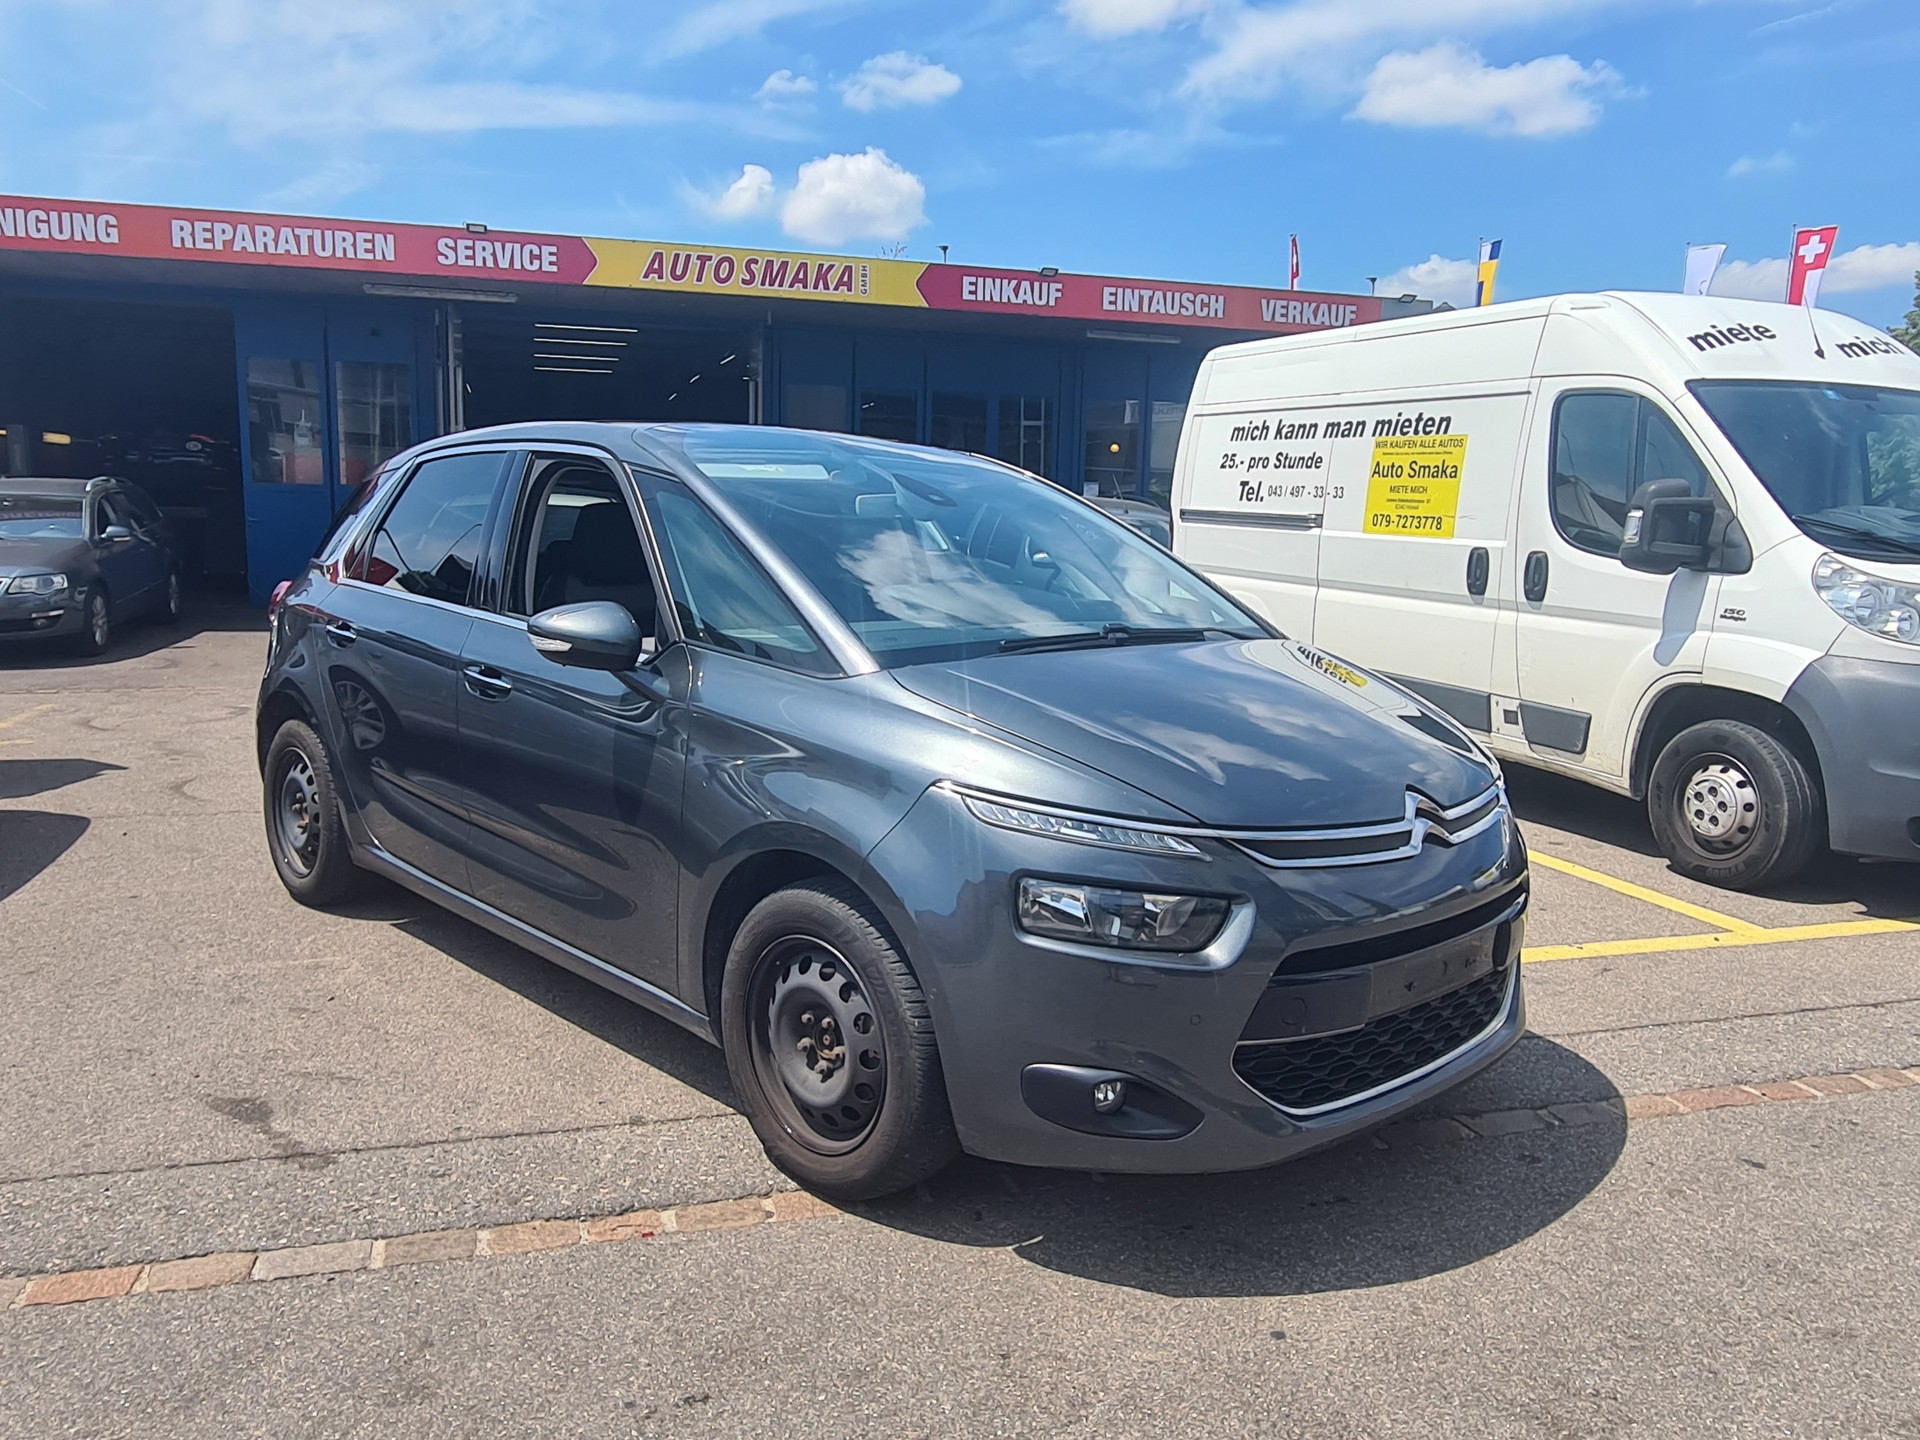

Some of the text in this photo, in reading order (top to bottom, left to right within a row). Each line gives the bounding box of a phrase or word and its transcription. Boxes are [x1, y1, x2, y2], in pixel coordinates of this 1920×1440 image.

[171, 219, 396, 262] REPARATUREN
[436, 237, 559, 273] SERVICE
[641, 249, 855, 295] AUTO SMAKA
[859, 263, 870, 295] GMBH
[961, 275, 1063, 306] EINKAUF
[1102, 286, 1225, 319] EINTAUSCH
[1261, 299, 1357, 327] VERKAUF
[1686, 322, 1777, 352] miete
[1835, 335, 1905, 359] mich
[1230, 411, 1452, 442] mich kann man mieten
[1389, 438, 1418, 449] KAUFEN
[1418, 438, 1437, 448] ALLE
[1437, 437, 1465, 448] AUTOS
[1219, 451, 1324, 473] 25.- pro Stunde
[1371, 460, 1459, 479] Auto Smaka
[1239, 480, 1265, 503] Tel.
[1267, 484, 1283, 498] 043
[1290, 485, 1307, 498] 497
[1313, 486, 1325, 499] 33
[1333, 486, 1345, 499] 33
[1389, 485, 1409, 494] MIETE
[1372, 513, 1443, 531] 079-7273778
